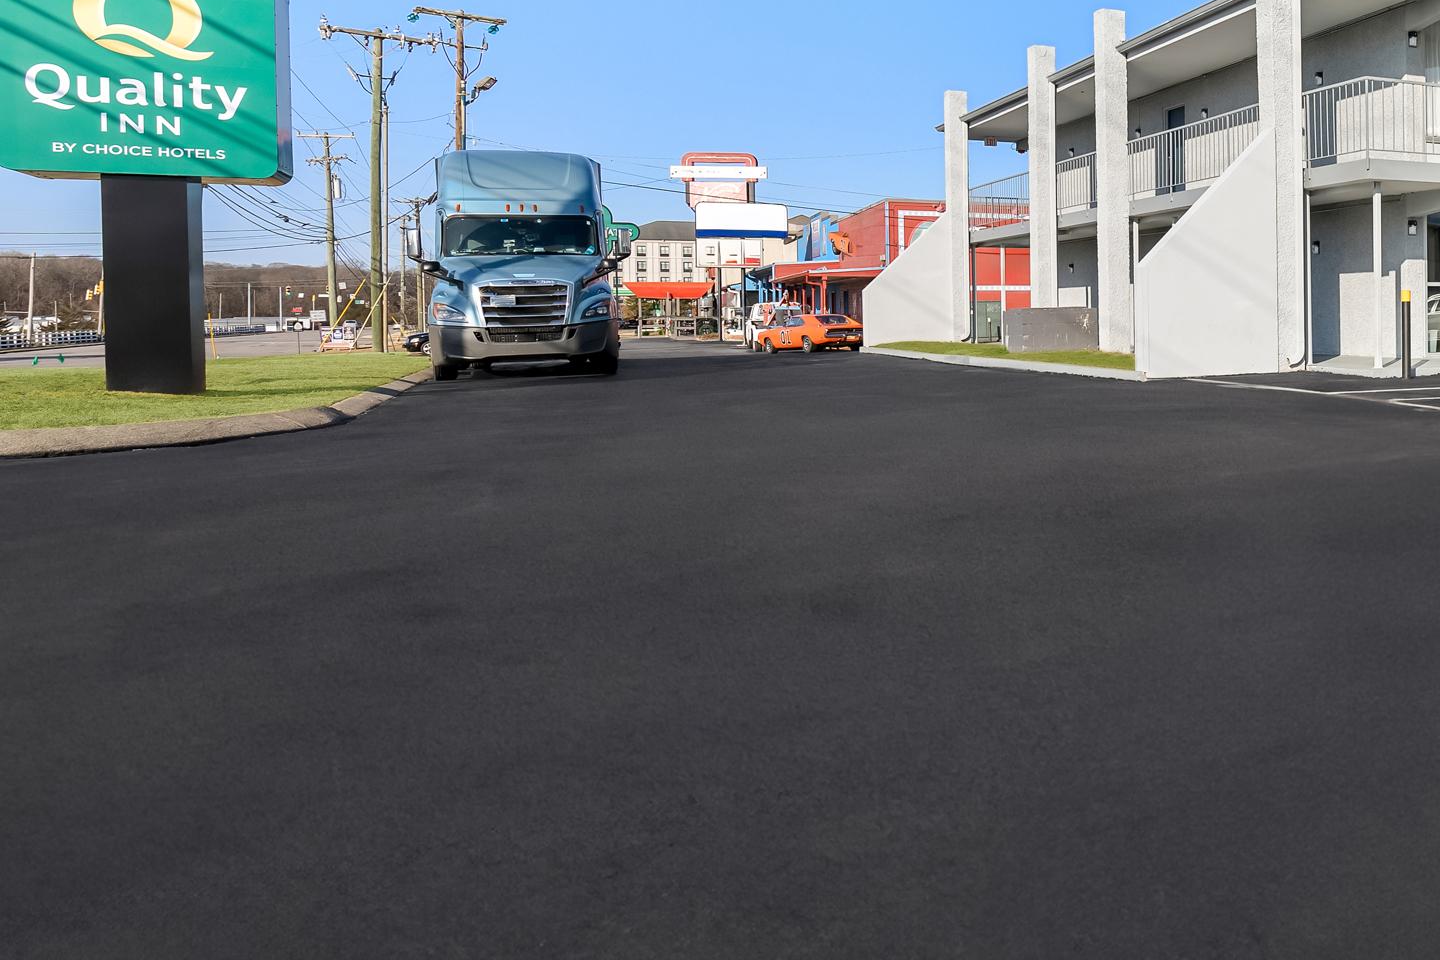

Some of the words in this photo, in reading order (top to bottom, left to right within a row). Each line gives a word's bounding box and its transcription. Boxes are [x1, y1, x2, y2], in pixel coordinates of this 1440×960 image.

[24, 63, 248, 121] Quality
[100, 112, 181, 136] INN
[52, 142, 76, 154] BY
[82, 143, 153, 157] CHOICE
[158, 147, 226, 160] HOTELS
